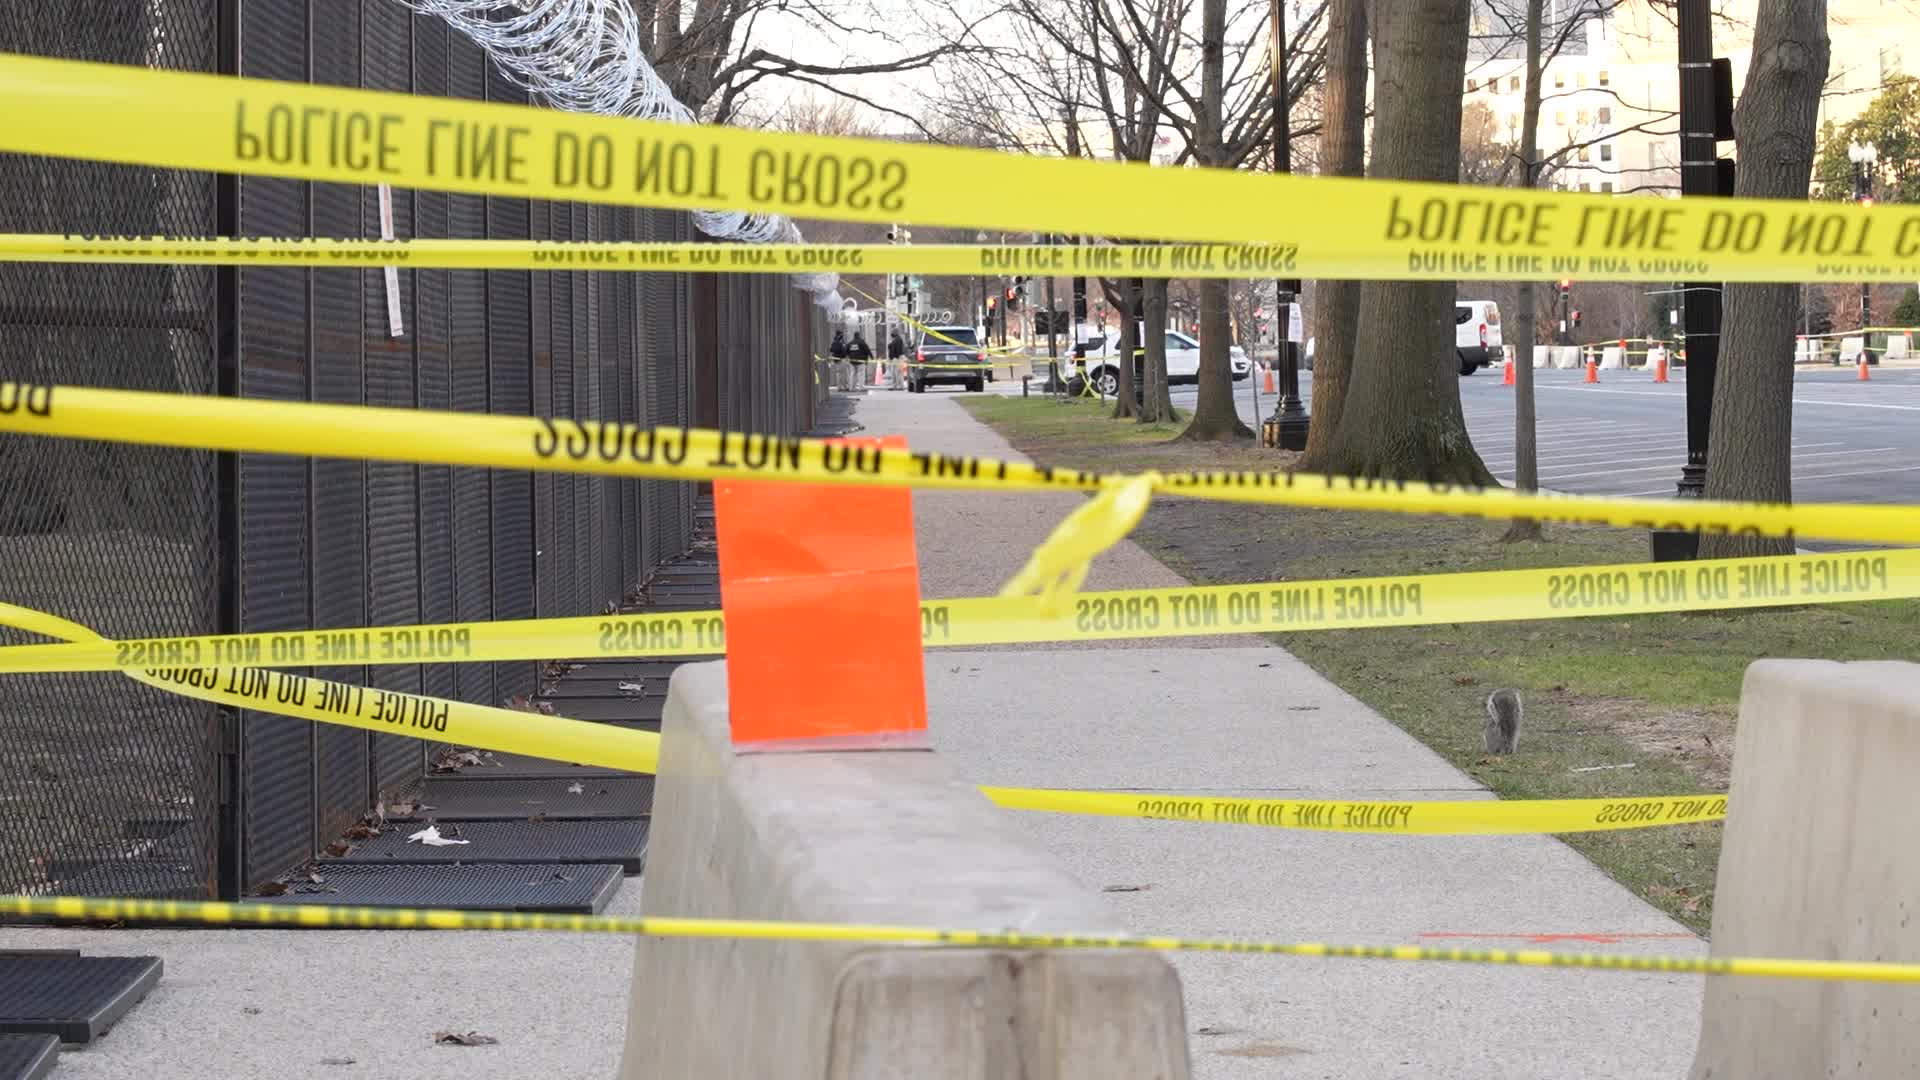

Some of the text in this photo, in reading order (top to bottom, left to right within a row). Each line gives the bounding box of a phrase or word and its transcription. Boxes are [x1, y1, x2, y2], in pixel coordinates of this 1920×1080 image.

[224, 667, 270, 699] NOT
[277, 676, 307, 706] DO
[314, 684, 364, 717] LINE
[371, 691, 449, 733] POLICE
